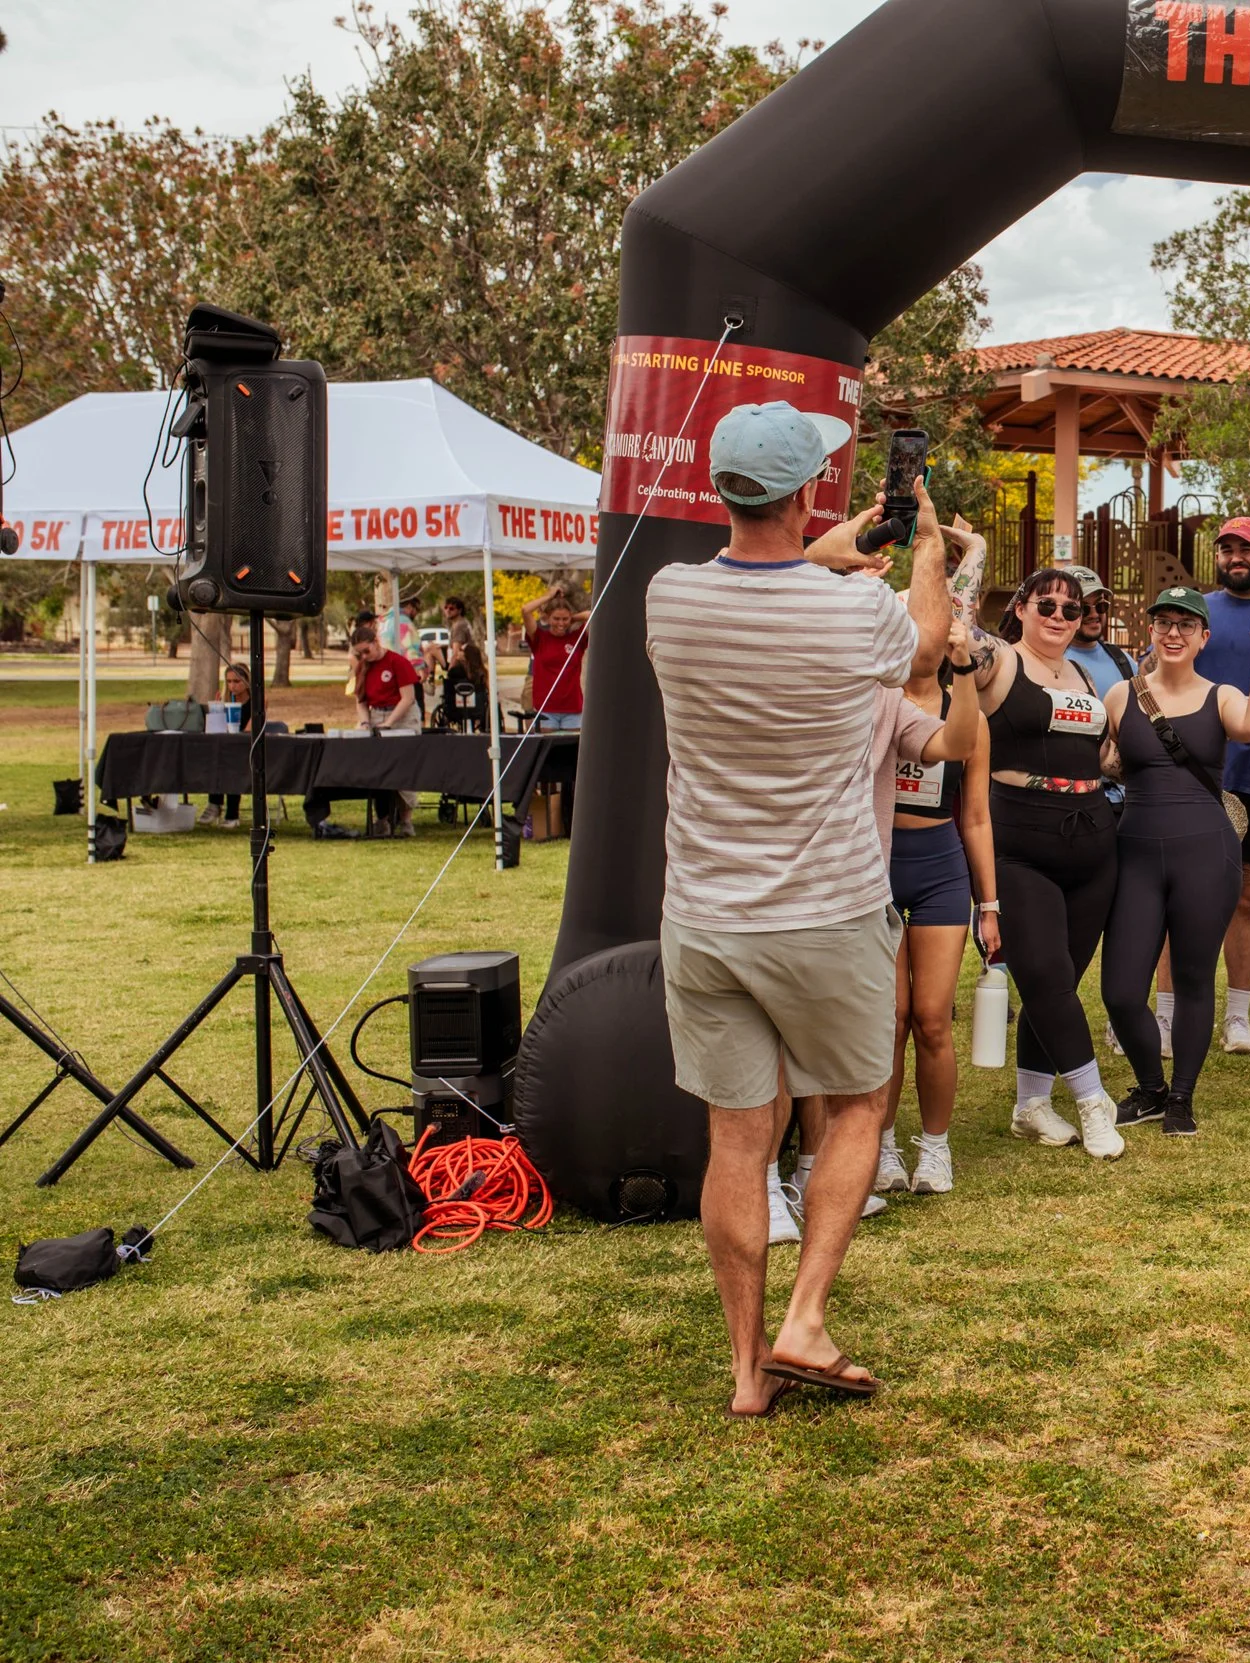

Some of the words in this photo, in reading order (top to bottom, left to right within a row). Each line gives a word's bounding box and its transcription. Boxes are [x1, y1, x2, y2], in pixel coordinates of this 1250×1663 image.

[631, 352, 698, 371] STARTING
[703, 358, 743, 377] LINE
[746, 364, 805, 384] SPONSOR
[838, 375, 859, 406] THE
[637, 485, 696, 504] Celebrating
[699, 491, 722, 504] Mas
[30, 520, 65, 551] 5K
[101, 519, 148, 550] THE
[156, 517, 186, 550] TA
[351, 506, 418, 541] TACO
[425, 504, 462, 538] 5K
[497, 504, 537, 540] THE
[539, 509, 586, 545] TACO
[590, 514, 599, 545] 5
[1065, 696, 1092, 711] 243
